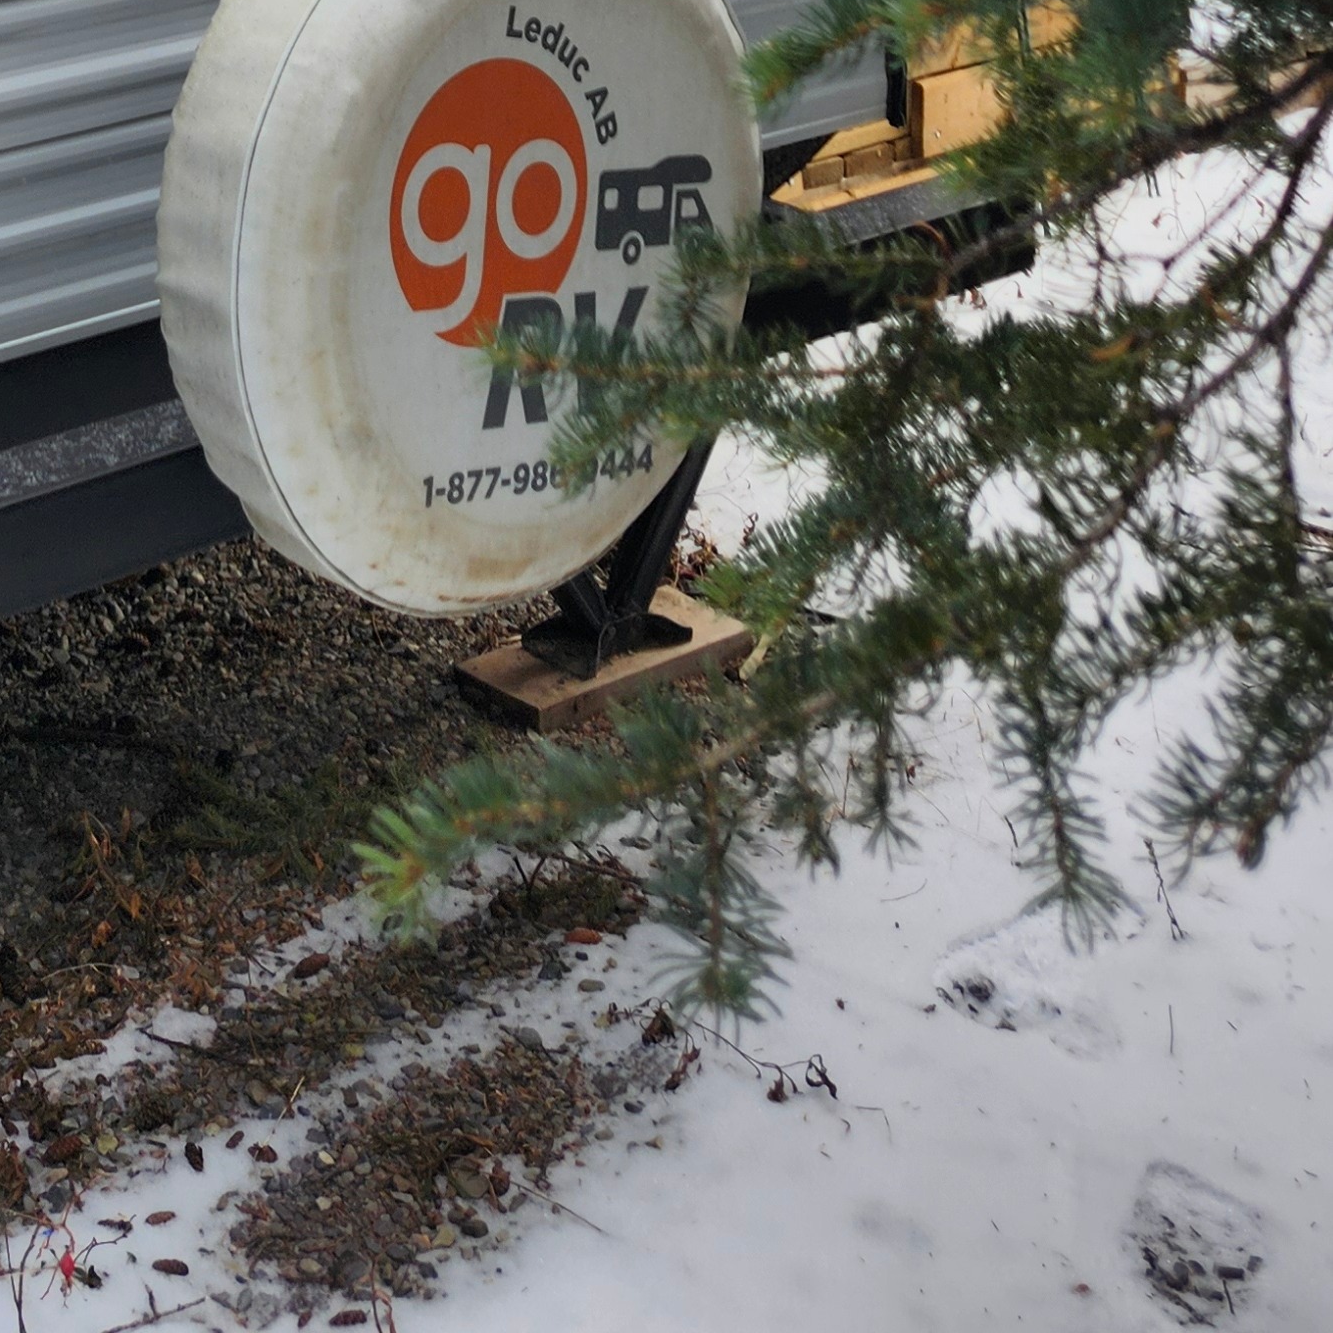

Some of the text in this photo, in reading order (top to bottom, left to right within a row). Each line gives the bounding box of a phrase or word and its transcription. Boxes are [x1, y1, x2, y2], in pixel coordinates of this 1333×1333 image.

[506, 5, 618, 145] Leduc AB
[401, 138, 578, 334] go
